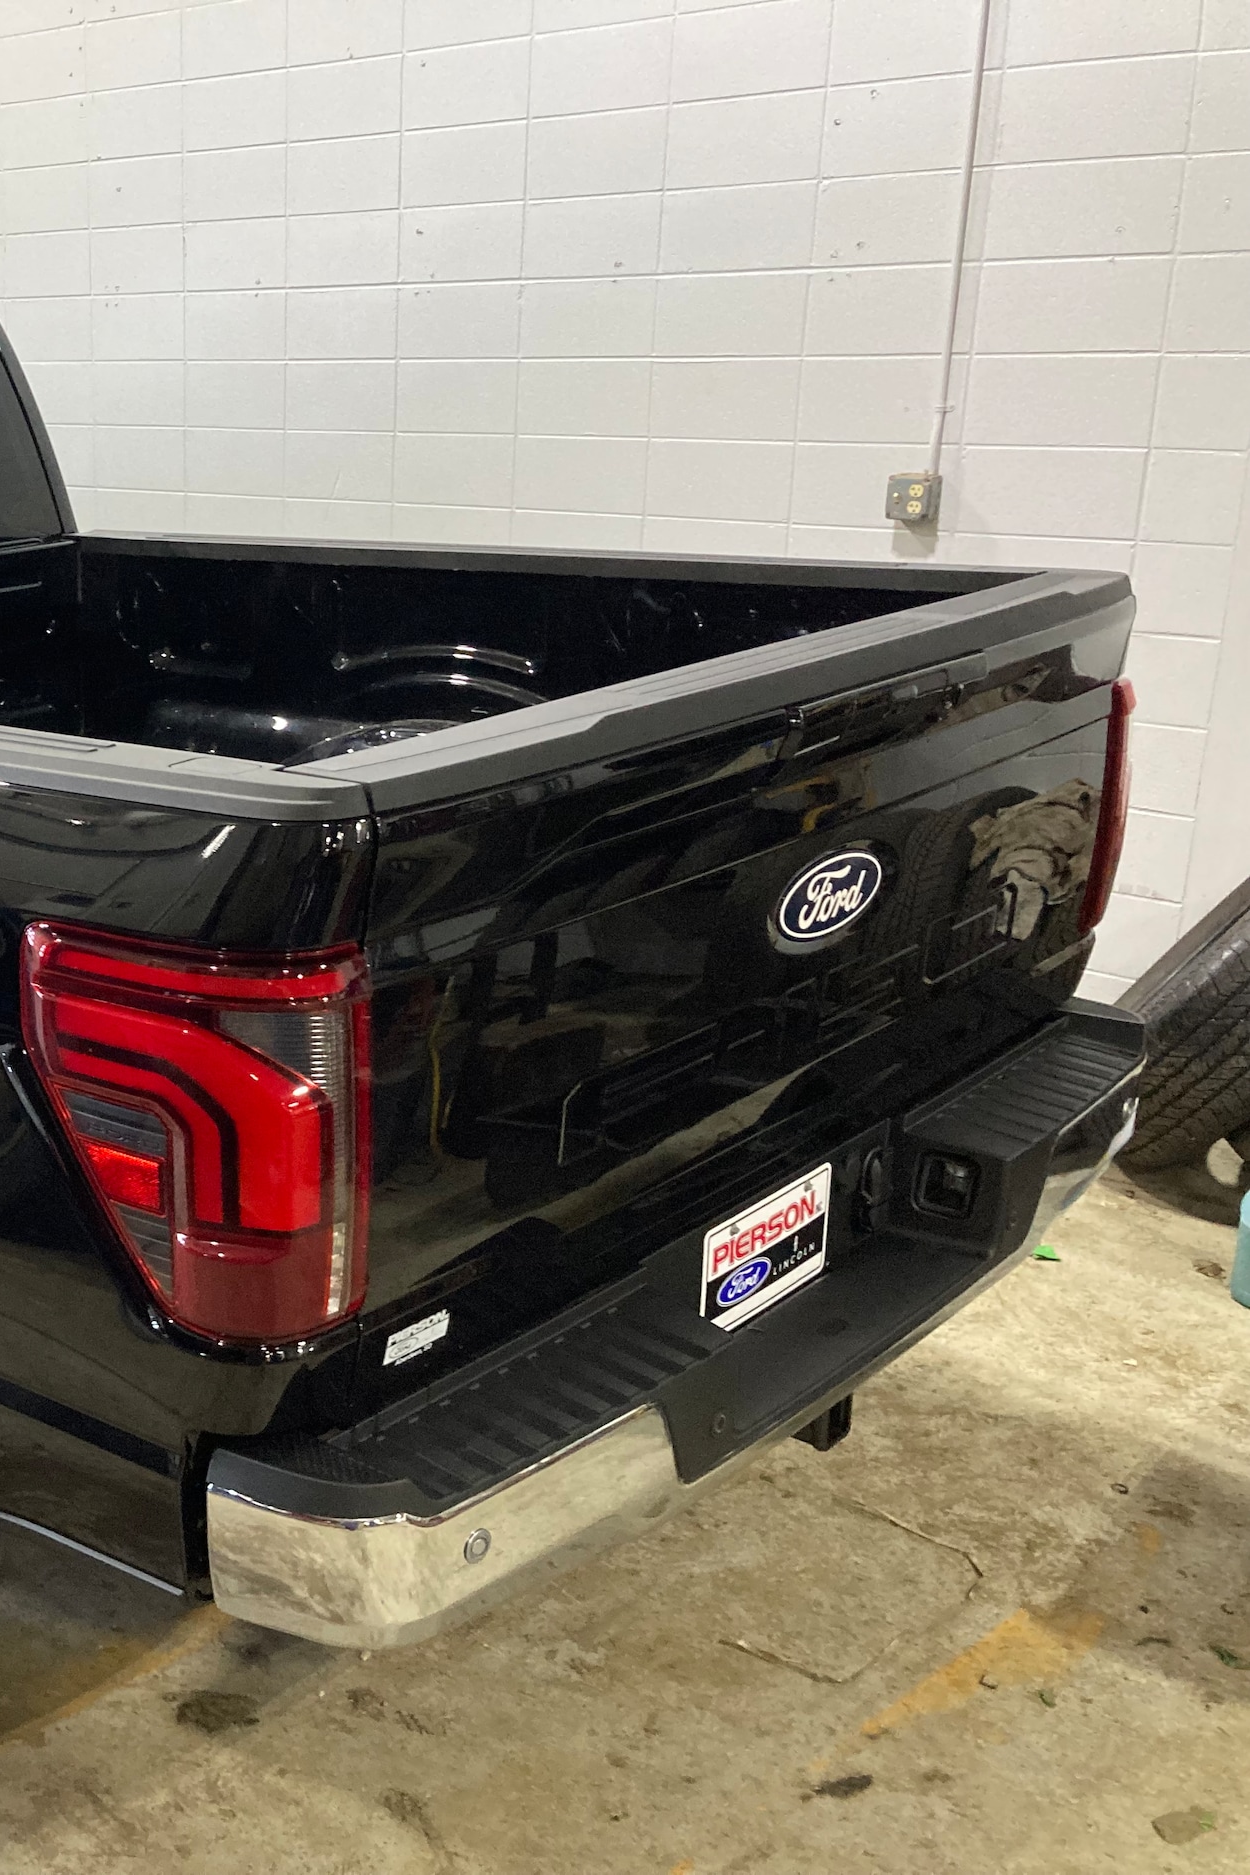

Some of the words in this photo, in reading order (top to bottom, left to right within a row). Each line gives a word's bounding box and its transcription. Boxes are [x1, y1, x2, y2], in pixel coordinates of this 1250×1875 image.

[798, 864, 867, 930] Ford
[711, 1190, 816, 1273] PIERSON
[726, 1266, 762, 1299] Ford
[772, 1241, 815, 1276] LINCOLN
